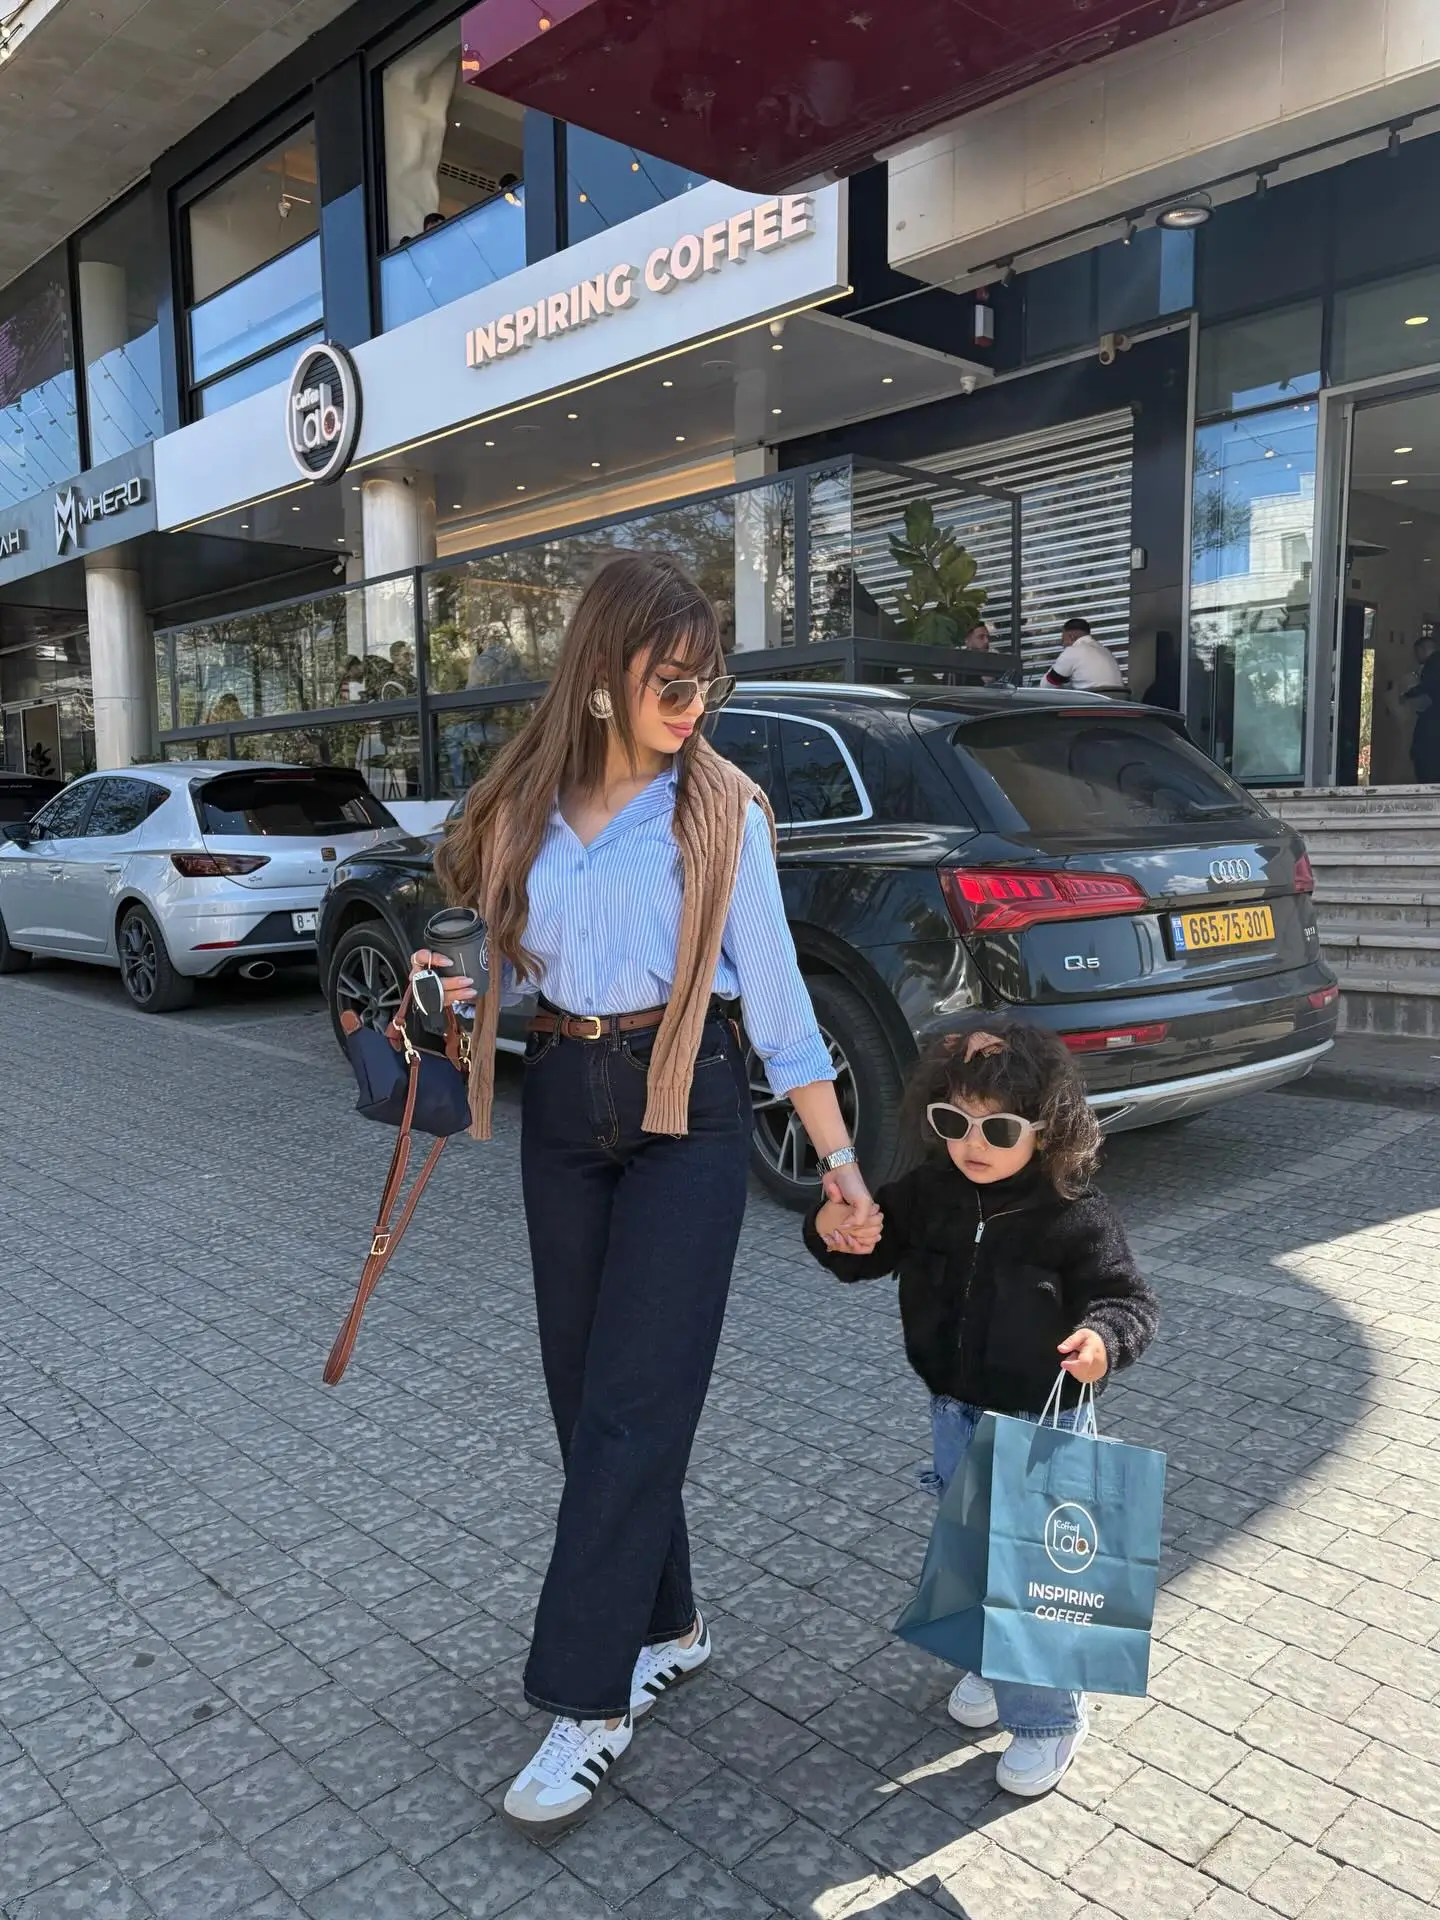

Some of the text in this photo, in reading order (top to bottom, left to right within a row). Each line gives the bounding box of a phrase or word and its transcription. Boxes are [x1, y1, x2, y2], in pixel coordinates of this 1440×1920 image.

[466, 193, 812, 368] INSPIRING COFFEE
[79, 476, 141, 524] MHERO
[1064, 955, 1100, 971] Q5
[1028, 1581, 1105, 1609] INSPIRING
[1035, 1605, 1094, 1627] COFFEE
